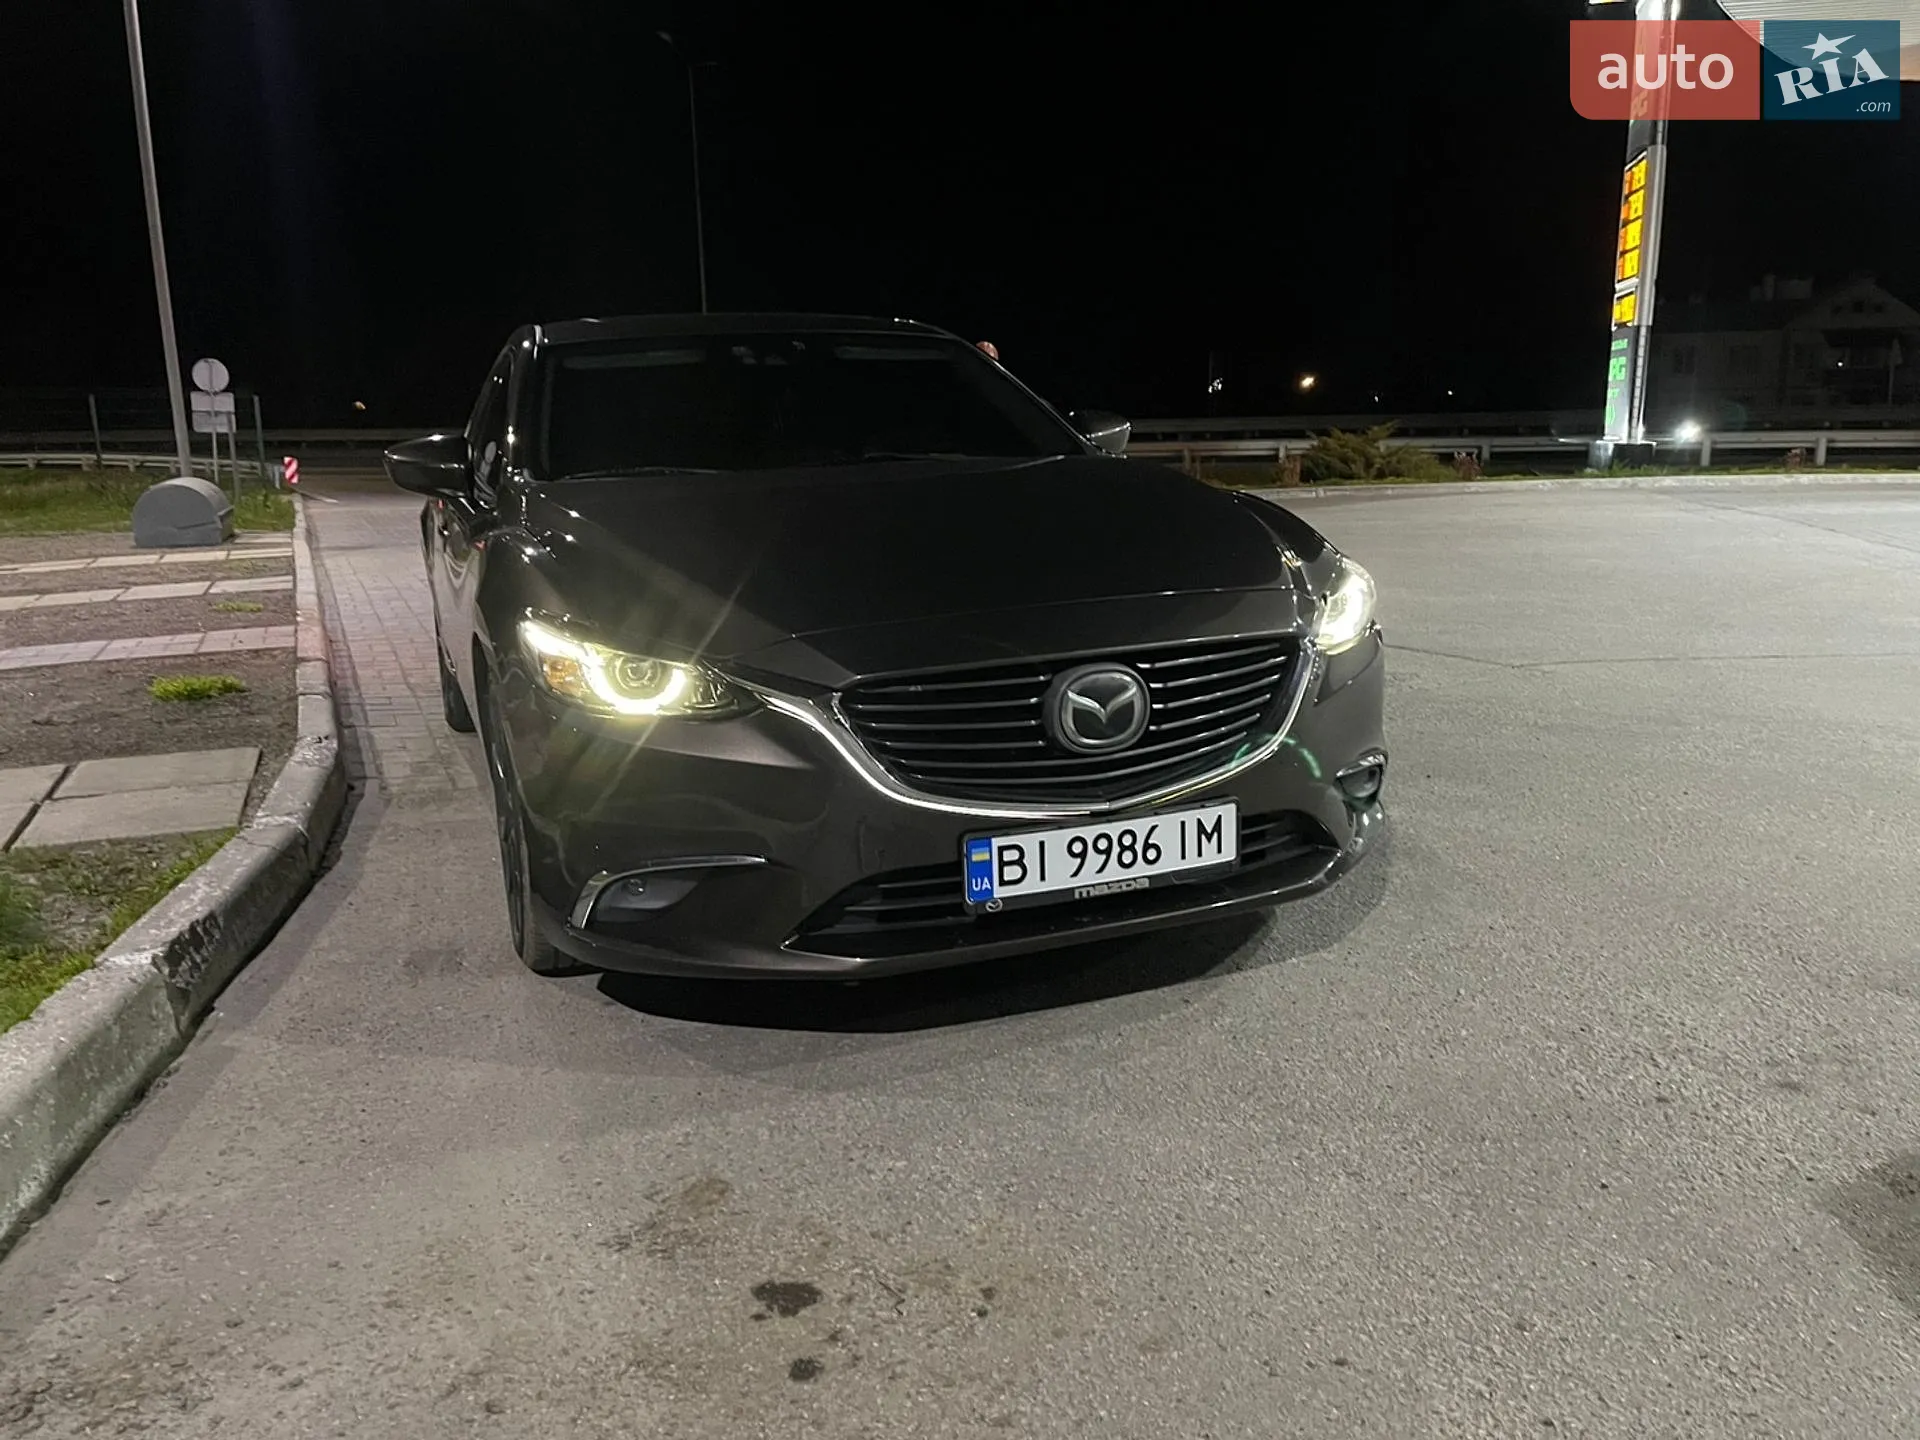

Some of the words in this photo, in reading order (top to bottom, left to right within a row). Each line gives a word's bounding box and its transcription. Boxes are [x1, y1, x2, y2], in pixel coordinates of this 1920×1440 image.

[997, 840, 1046, 887] BI
[1066, 824, 1162, 878] 9986
[1180, 814, 1223, 860] IM
[972, 877, 991, 892] UA
